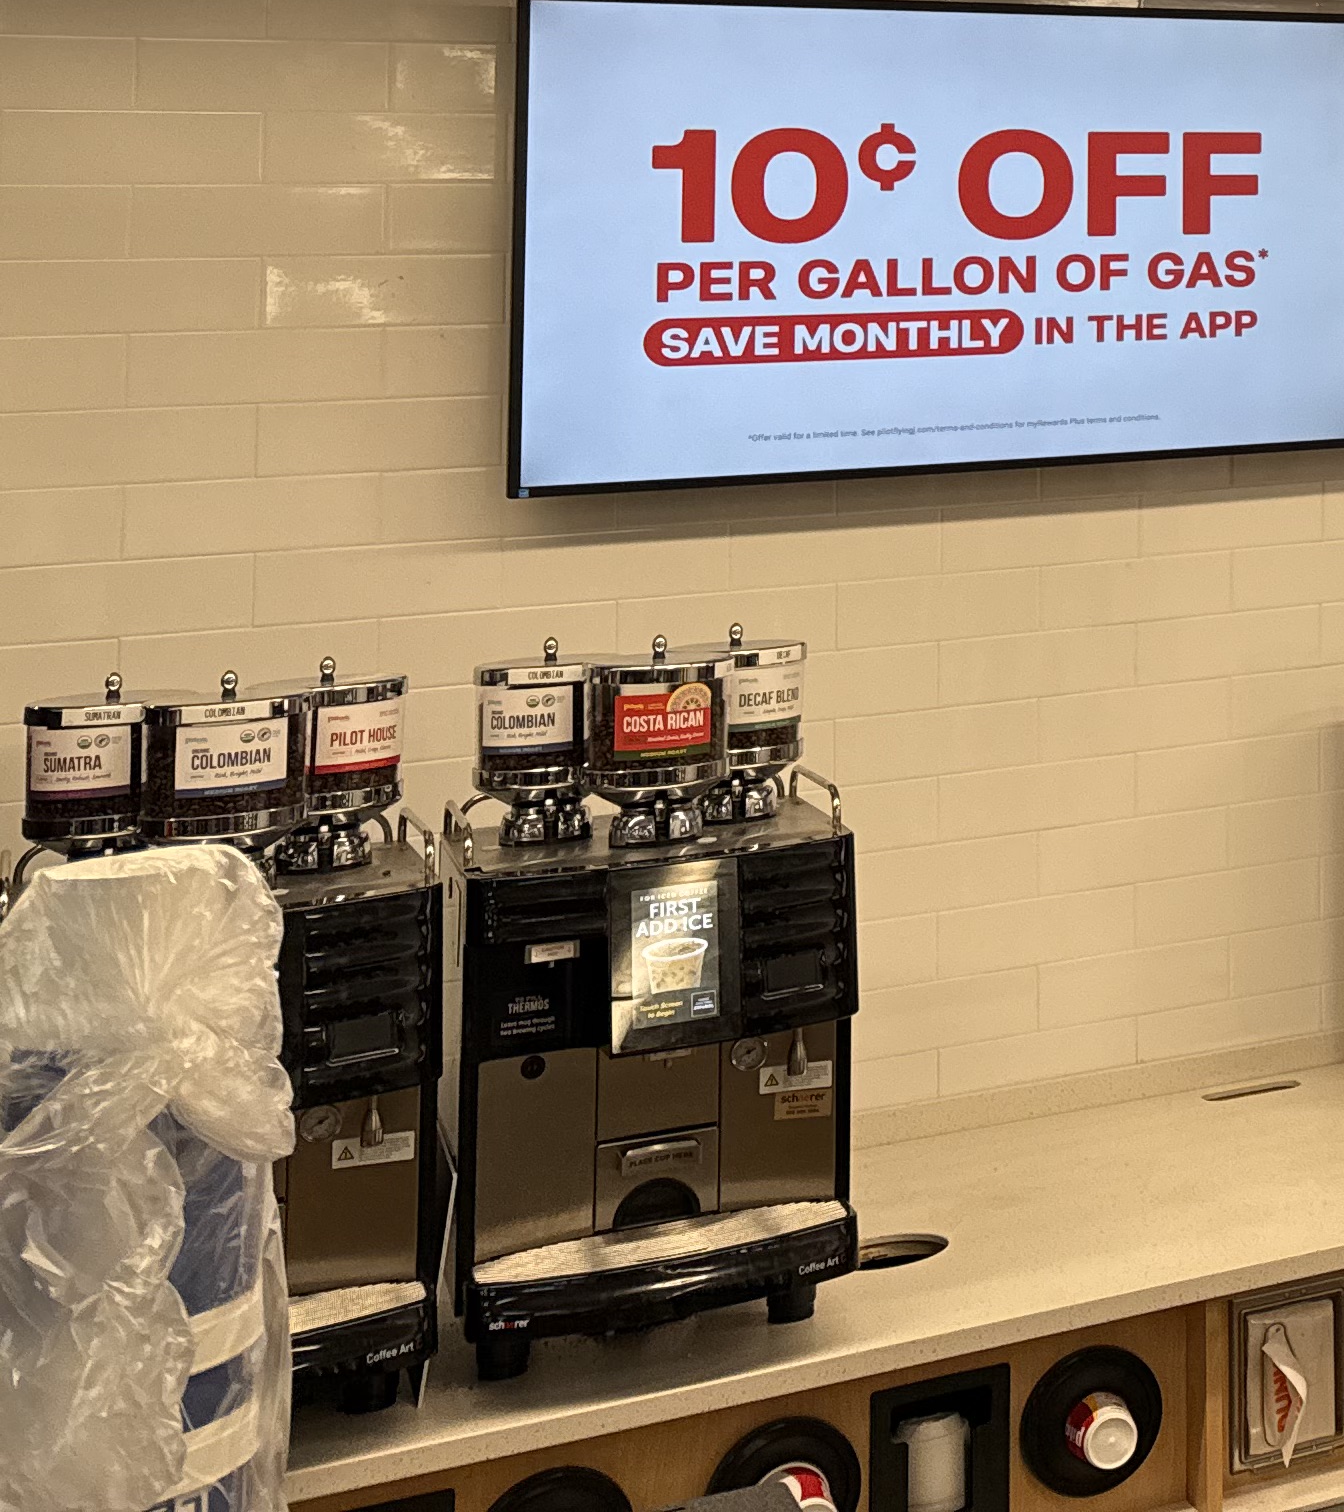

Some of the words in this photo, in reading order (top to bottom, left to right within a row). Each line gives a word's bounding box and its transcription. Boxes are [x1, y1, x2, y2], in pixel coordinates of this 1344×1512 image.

[651, 122, 917, 244] 10¢
[957, 128, 1262, 240] OFF
[656, 260, 776, 303] PER
[798, 253, 1036, 299] GALLON
[1054, 253, 1129, 291] OF
[659, 321, 780, 361] SAVE
[793, 317, 1009, 355] MONTHLY
[1034, 315, 1073, 345] IN
[1093, 313, 1168, 343] THE
[1179, 309, 1258, 339] APP
[528, 670, 564, 680] COLOMBIAN
[738, 690, 774, 707] DECAF
[204, 706, 246, 719] COLOMBIAN
[490, 712, 556, 730] COLOMBIAN
[623, 715, 664, 733] COSTA
[667, 710, 704, 730] RICAN
[330, 729, 366, 747] PILOT
[368, 724, 397, 744] HOUSE
[43, 754, 102, 773] SUMATRA
[191, 747, 271, 770] COLOMBIAN
[649, 897, 702, 919] FIRST
[636, 918, 679, 938] ADD
[682, 912, 714, 932] ICE
[507, 998, 550, 1015] THERMOS
[780, 1092, 826, 1104] schaerer
[799, 1259, 826, 1276] Coffee
[827, 1255, 839, 1268] Art
[488, 1317, 529, 1331] schaerer
[366, 1346, 397, 1365] Coffee
[399, 1341, 415, 1354] Art
